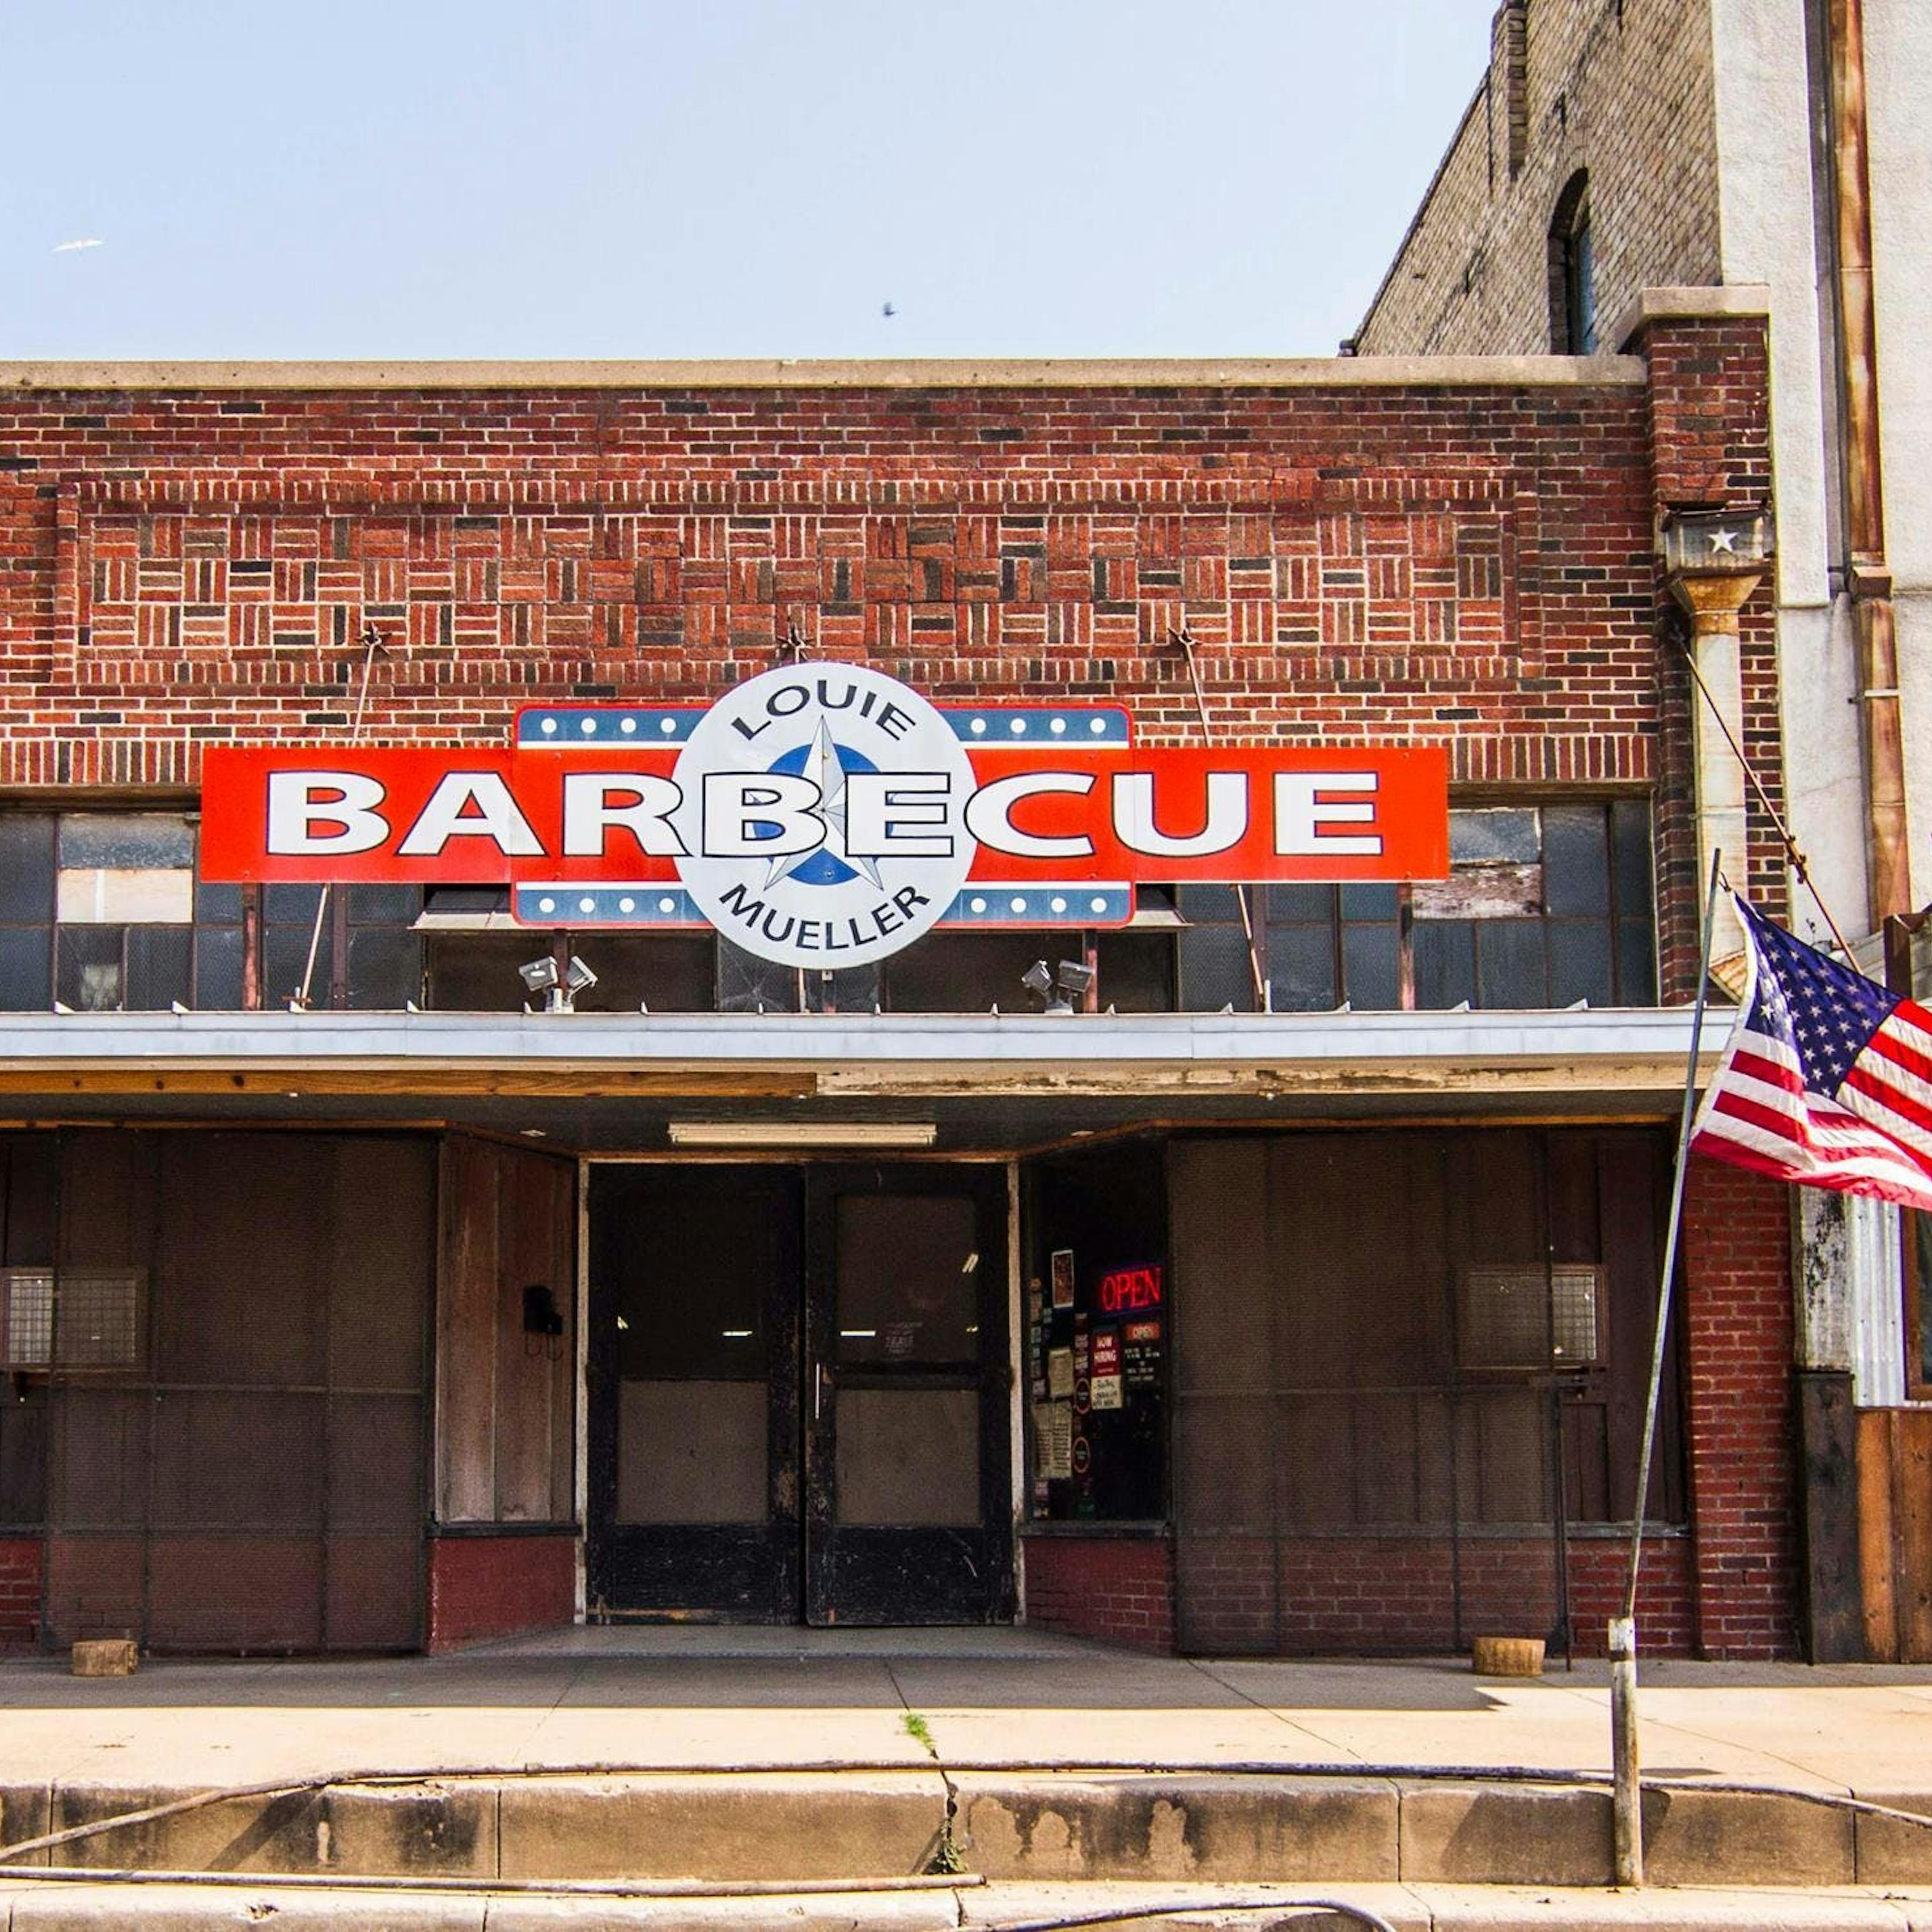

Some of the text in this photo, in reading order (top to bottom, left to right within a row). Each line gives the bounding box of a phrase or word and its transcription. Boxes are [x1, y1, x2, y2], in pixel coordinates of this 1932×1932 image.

[731, 680, 916, 741] LOUIE
[266, 771, 1384, 858] BARBECUE
[718, 883, 931, 950] MUELLER
[1101, 1266, 1163, 1311] OPEN
